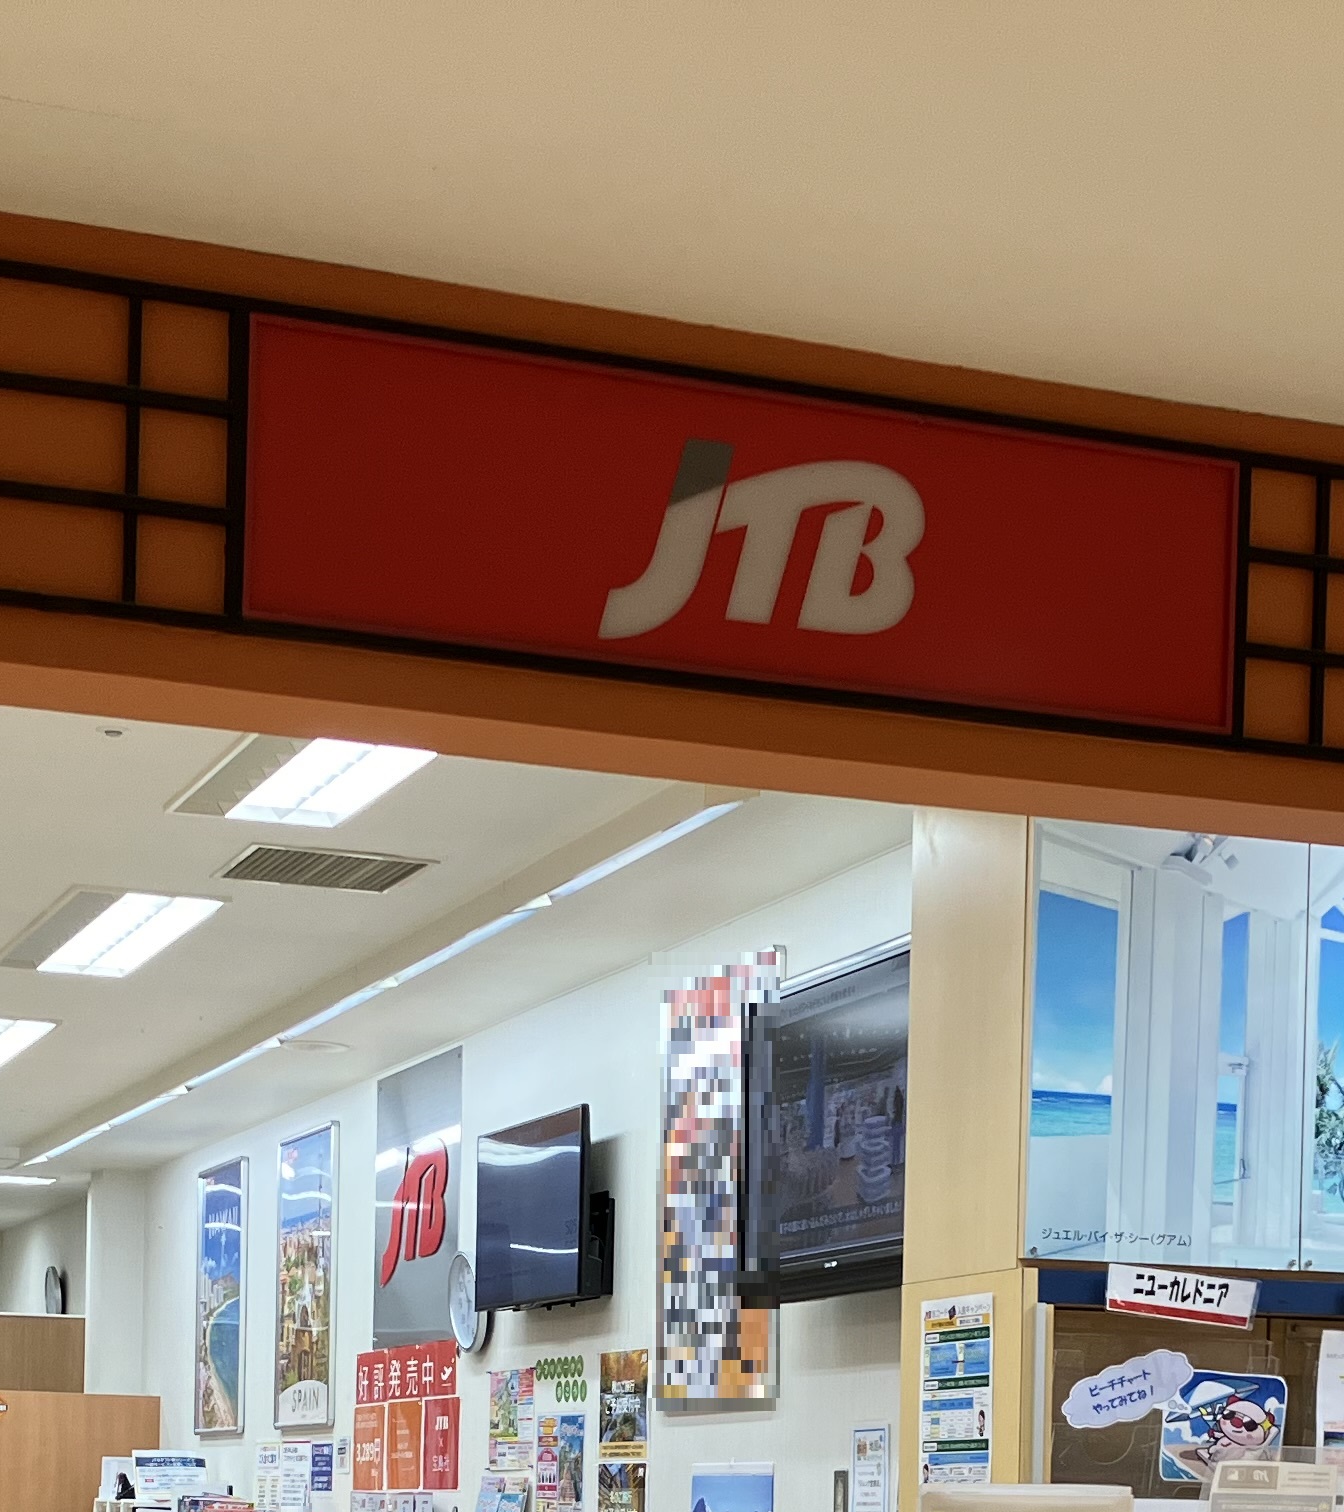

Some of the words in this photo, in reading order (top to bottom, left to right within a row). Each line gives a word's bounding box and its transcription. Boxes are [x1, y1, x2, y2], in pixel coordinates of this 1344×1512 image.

[597, 437, 927, 640] JTB
[380, 1137, 448, 1288] JTB
[1133, 1273, 1229, 1308] ニューカレドニア
[358, 1355, 434, 1401] 好評発売中
[1089, 1369, 1151, 1397] ビーチチャート
[292, 1390, 320, 1412] SPAIN
[436, 1416, 448, 1430] JTB
